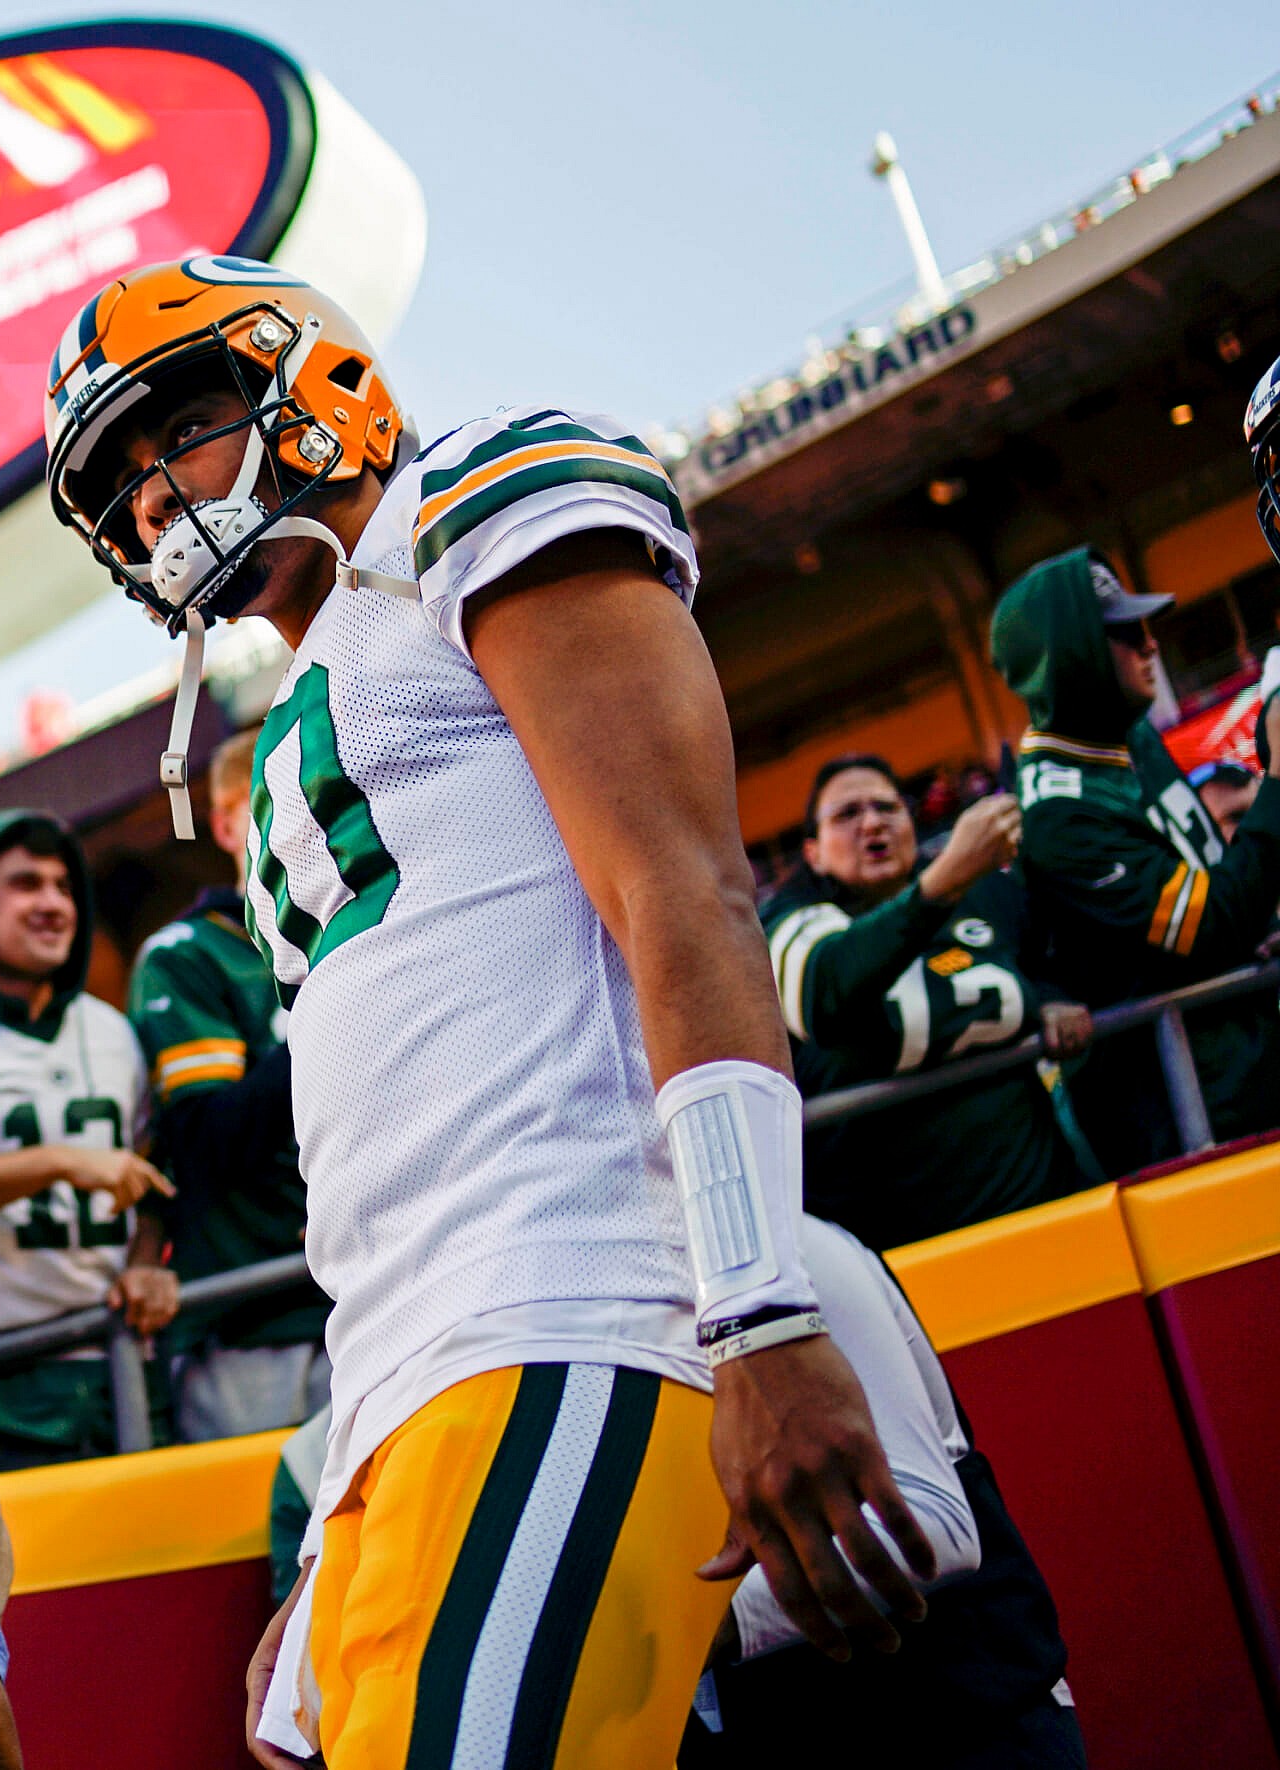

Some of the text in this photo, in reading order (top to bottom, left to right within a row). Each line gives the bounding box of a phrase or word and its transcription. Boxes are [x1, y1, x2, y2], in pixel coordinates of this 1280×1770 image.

[62, 377, 100, 418] ACKERS
[245, 661, 401, 1011] 0
[4, 1097, 128, 1248] 12
